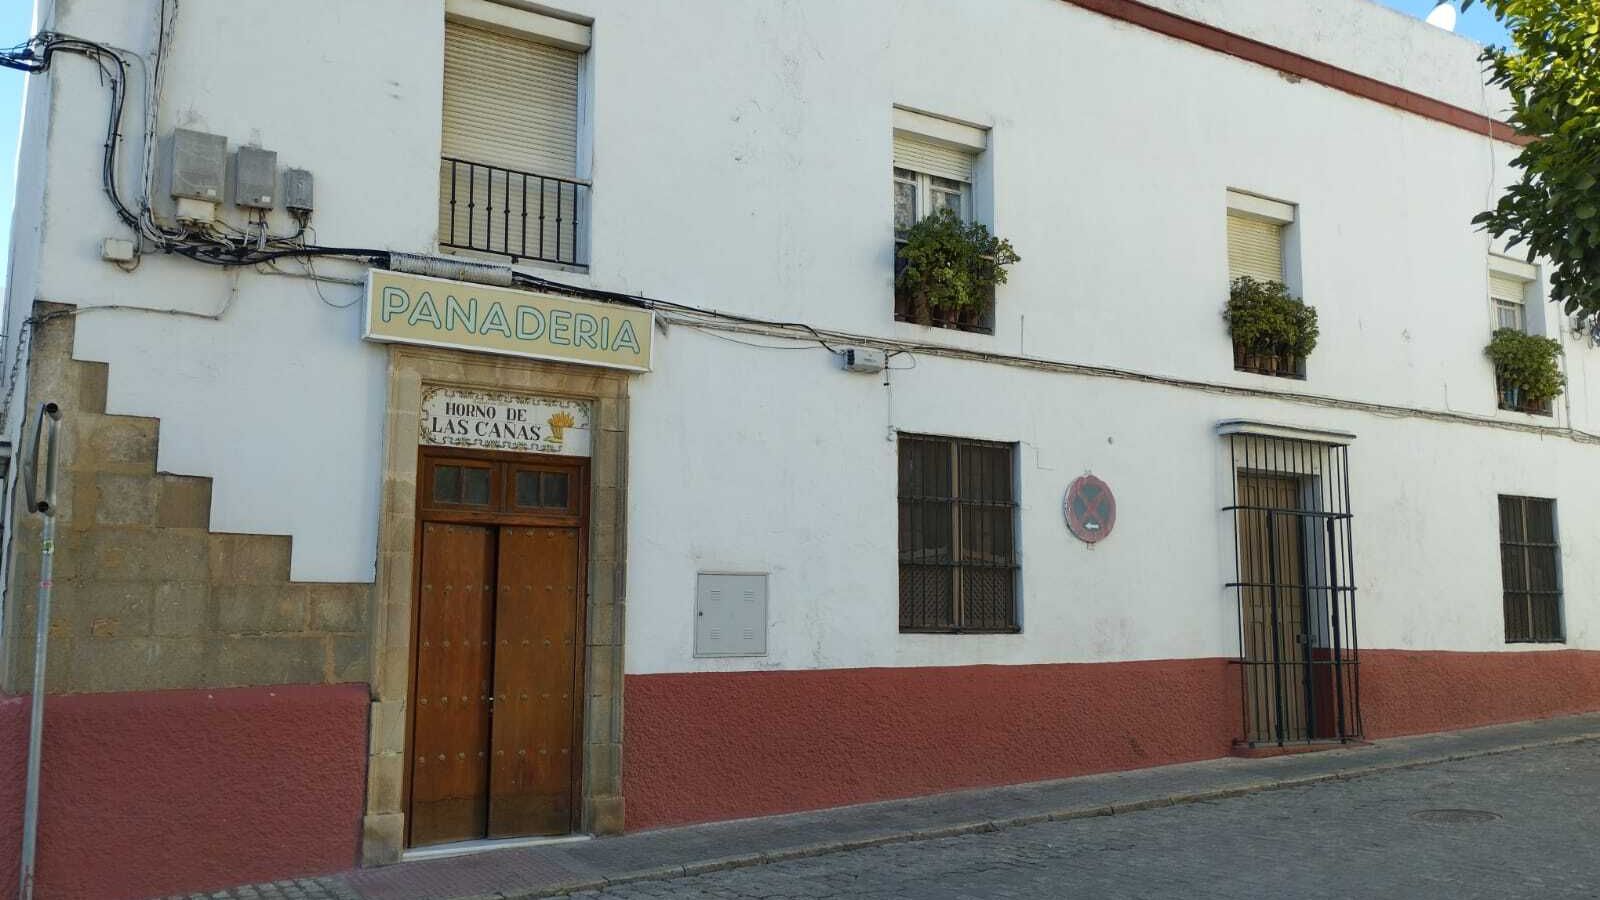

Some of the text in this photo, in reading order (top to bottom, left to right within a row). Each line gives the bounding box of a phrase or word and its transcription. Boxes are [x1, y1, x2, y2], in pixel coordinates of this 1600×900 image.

[381, 286, 641, 354] PANADERIA
[446, 402, 527, 422] HORNO DE
[431, 416, 469, 435] LAS
